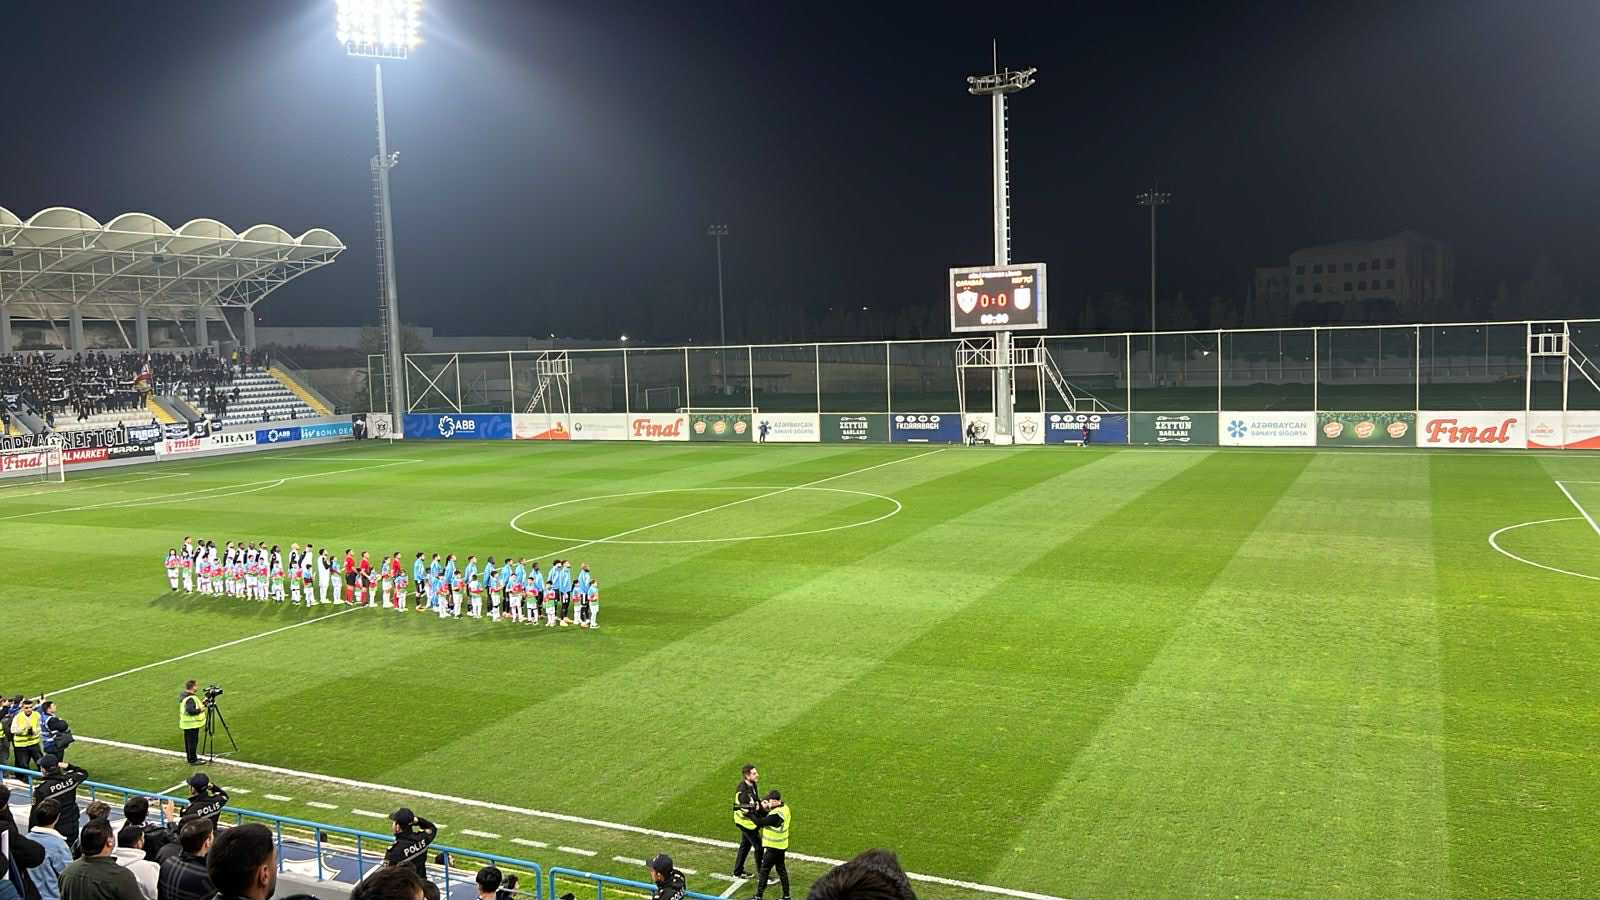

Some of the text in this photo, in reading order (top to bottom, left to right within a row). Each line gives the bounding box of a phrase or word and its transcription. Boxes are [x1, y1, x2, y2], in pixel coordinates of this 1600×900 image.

[455, 419, 476, 430] ABB
[632, 418, 684, 437] Final
[1425, 418, 1517, 443] Final
[211, 432, 255, 444] SIRAB
[73, 448, 107, 460] MARKET
[108, 445, 139, 455] FERRO
[4, 453, 43, 470] Final
